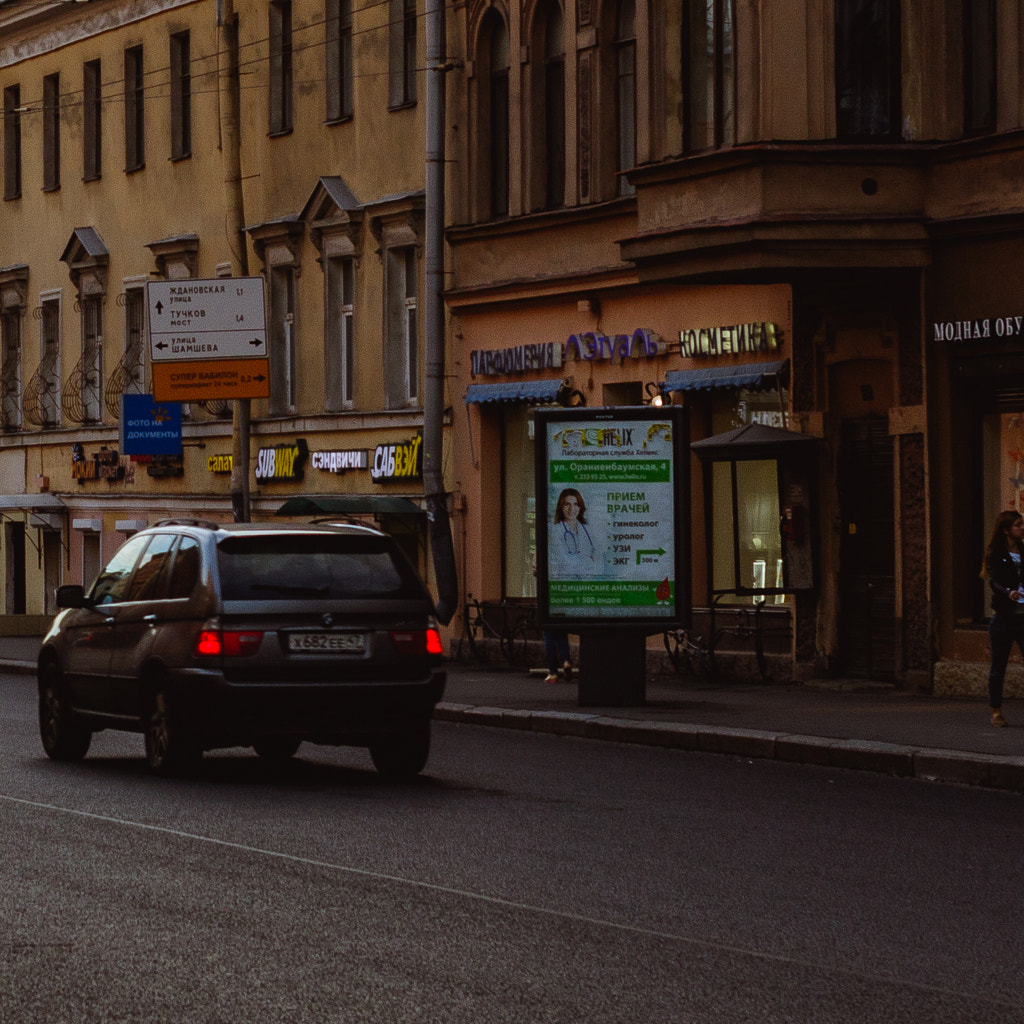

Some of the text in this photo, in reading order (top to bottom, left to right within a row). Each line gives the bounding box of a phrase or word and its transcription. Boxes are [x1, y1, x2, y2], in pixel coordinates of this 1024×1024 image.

[169, 285, 226, 295] ЖДАНОВСКАЯ
[169, 296, 192, 305] улица
[170, 309, 206, 318] ТУЧКОВ
[170, 319, 192, 327] мост
[933, 316, 1024, 343] МОДНАЯ ОБУ
[171, 337, 196, 345] улица
[678, 323, 771, 358] КОСМЕТИКА
[171, 344, 219, 354] ШАМШЕВА
[470, 342, 555, 376] ПАРФЮМЕРИЯ
[169, 372, 198, 382] СУПЕР
[127, 419, 164, 428] ФОТО НА
[127, 430, 179, 439] ДОКУМЕНТЫ
[602, 427, 634, 446] HELIX
[371, 433, 422, 478] САБВЭЙ
[561, 449, 608, 457] Лабораторная
[609, 448, 635, 457] служба
[255, 445, 301, 478] SUBWAY
[311, 450, 362, 473] сэндвичи
[553, 461, 667, 473] ул. Ораниенбаумская, 4
[606, 492, 646, 502] ПРИЕМ
[606, 503, 650, 514] ВРАЧЕЙ
[612, 520, 659, 528] гинеколог
[612, 533, 645, 542] уролог
[612, 544, 632, 553] УЗИ
[612, 557, 630, 566] ЭКГ
[550, 583, 650, 593] МЕДИЦИНСКИЕ АНАЛИЗЫ
